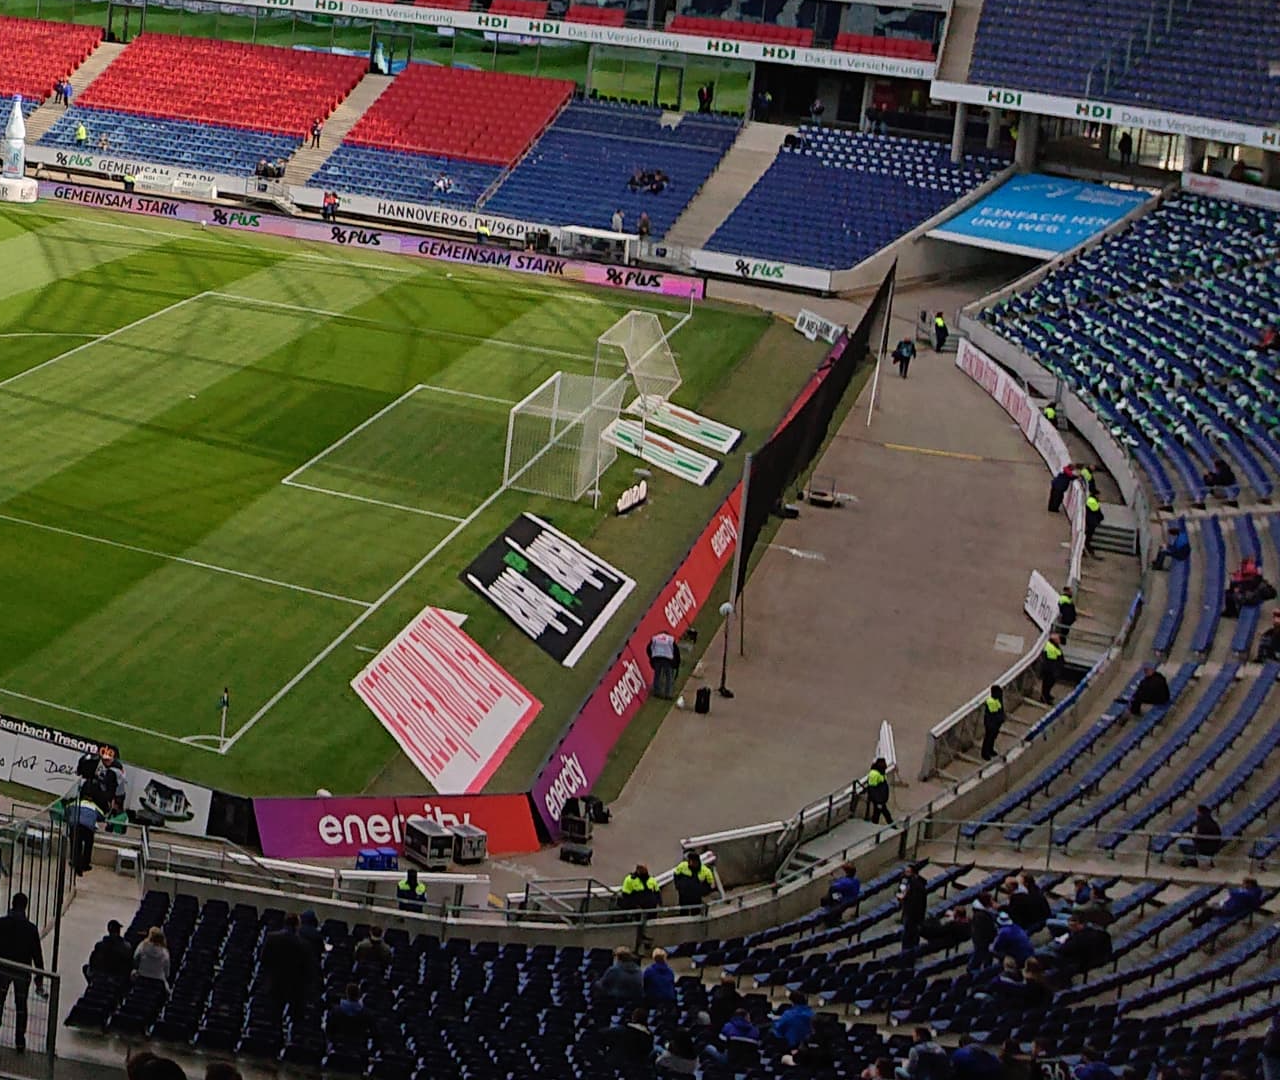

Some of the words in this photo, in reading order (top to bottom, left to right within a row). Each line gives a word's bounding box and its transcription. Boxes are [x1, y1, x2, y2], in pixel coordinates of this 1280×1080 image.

[315, 0, 344, 11] HDI
[478, 16, 508, 29] HDI
[529, 21, 560, 34] HDI
[707, 40, 739, 54] HDI
[762, 47, 795, 61] HDI
[804, 53, 822, 64] Das
[826, 56, 842, 66] ist
[988, 91, 1022, 107] HDI
[1076, 104, 1112, 120] HDI
[1121, 112, 1144, 124] Das
[1148, 116, 1163, 127] ist
[54, 187, 133, 209] GEMEINSAM
[136, 198, 179, 216] STARK
[418, 241, 512, 266] GEMEINSAM
[516, 255, 566, 275] STARK
[710, 515, 738, 558] enercity
[664, 580, 696, 628] enercity
[609, 658, 646, 715] enercity
[545, 752, 587, 821] enercity
